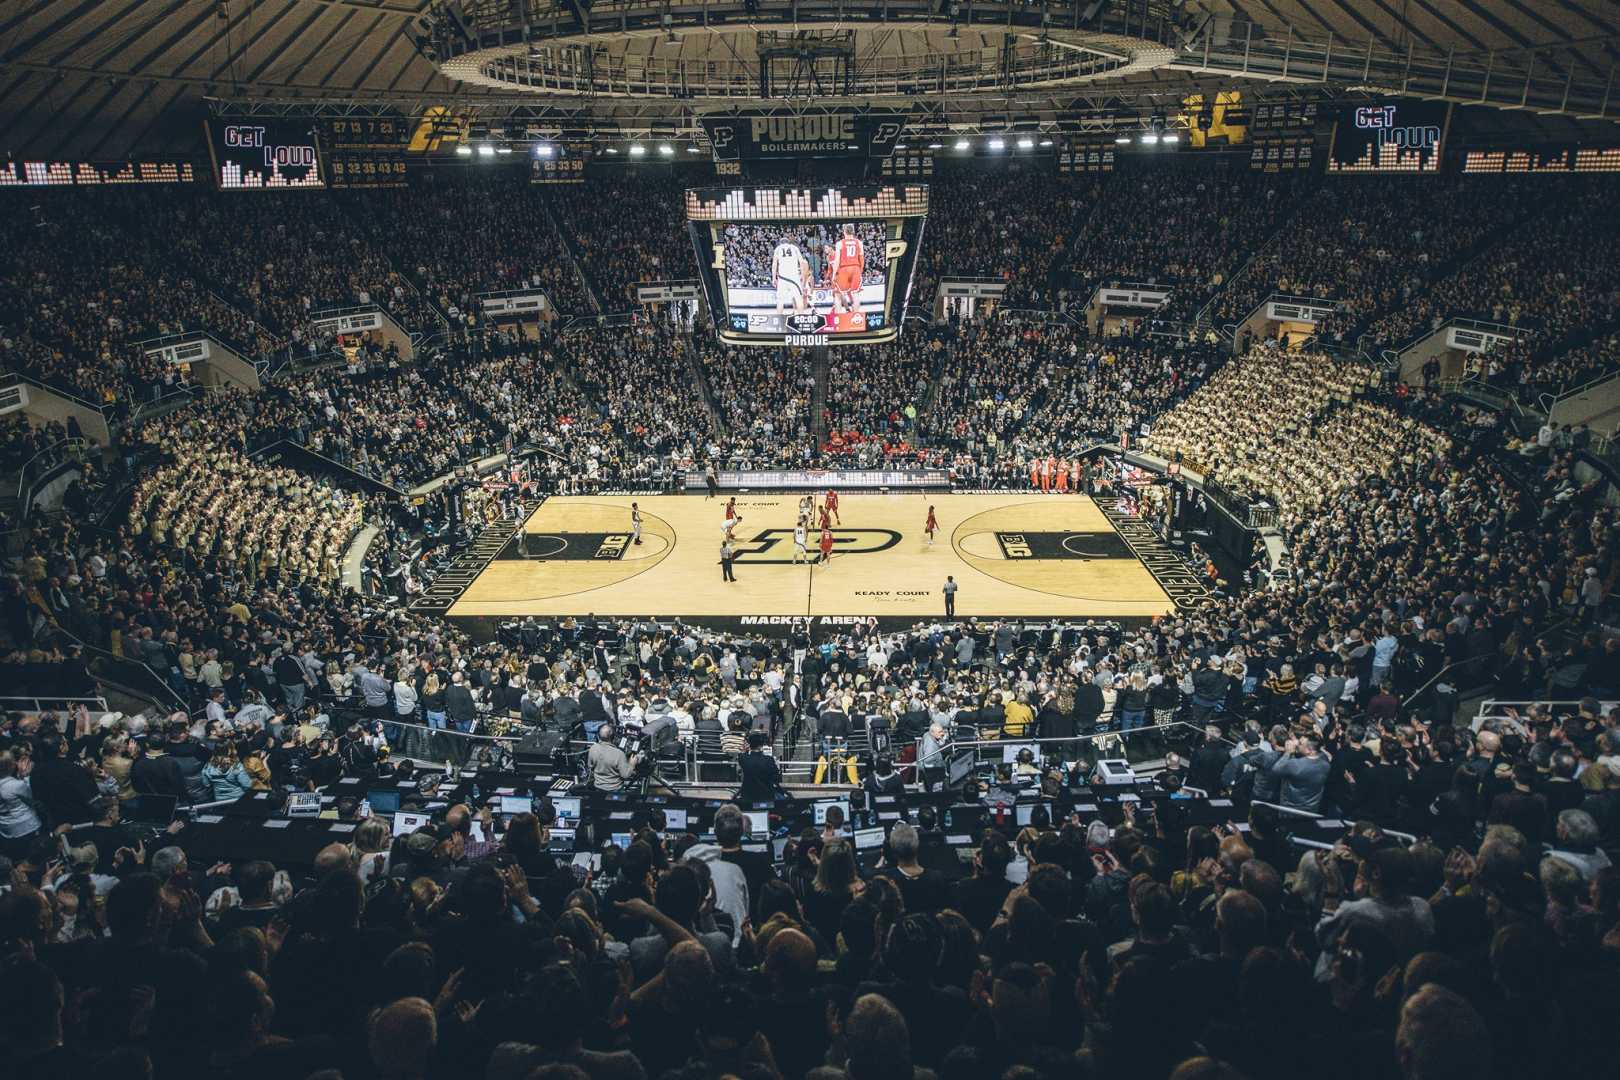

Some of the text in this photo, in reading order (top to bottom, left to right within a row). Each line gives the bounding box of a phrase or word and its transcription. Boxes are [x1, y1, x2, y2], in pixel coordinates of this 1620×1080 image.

[1356, 106, 1396, 128] GET
[751, 114, 855, 141] PURDUE
[224, 126, 265, 147] GET
[1379, 127, 1440, 148] LOUD
[761, 142, 847, 152] BOILERMAKERS
[264, 146, 315, 166] LOUD
[715, 163, 741, 174] 1932
[781, 247, 792, 257] 14
[846, 245, 856, 257] 10
[785, 335, 830, 346] PURDUE
[740, 616, 815, 625] MACKEY
